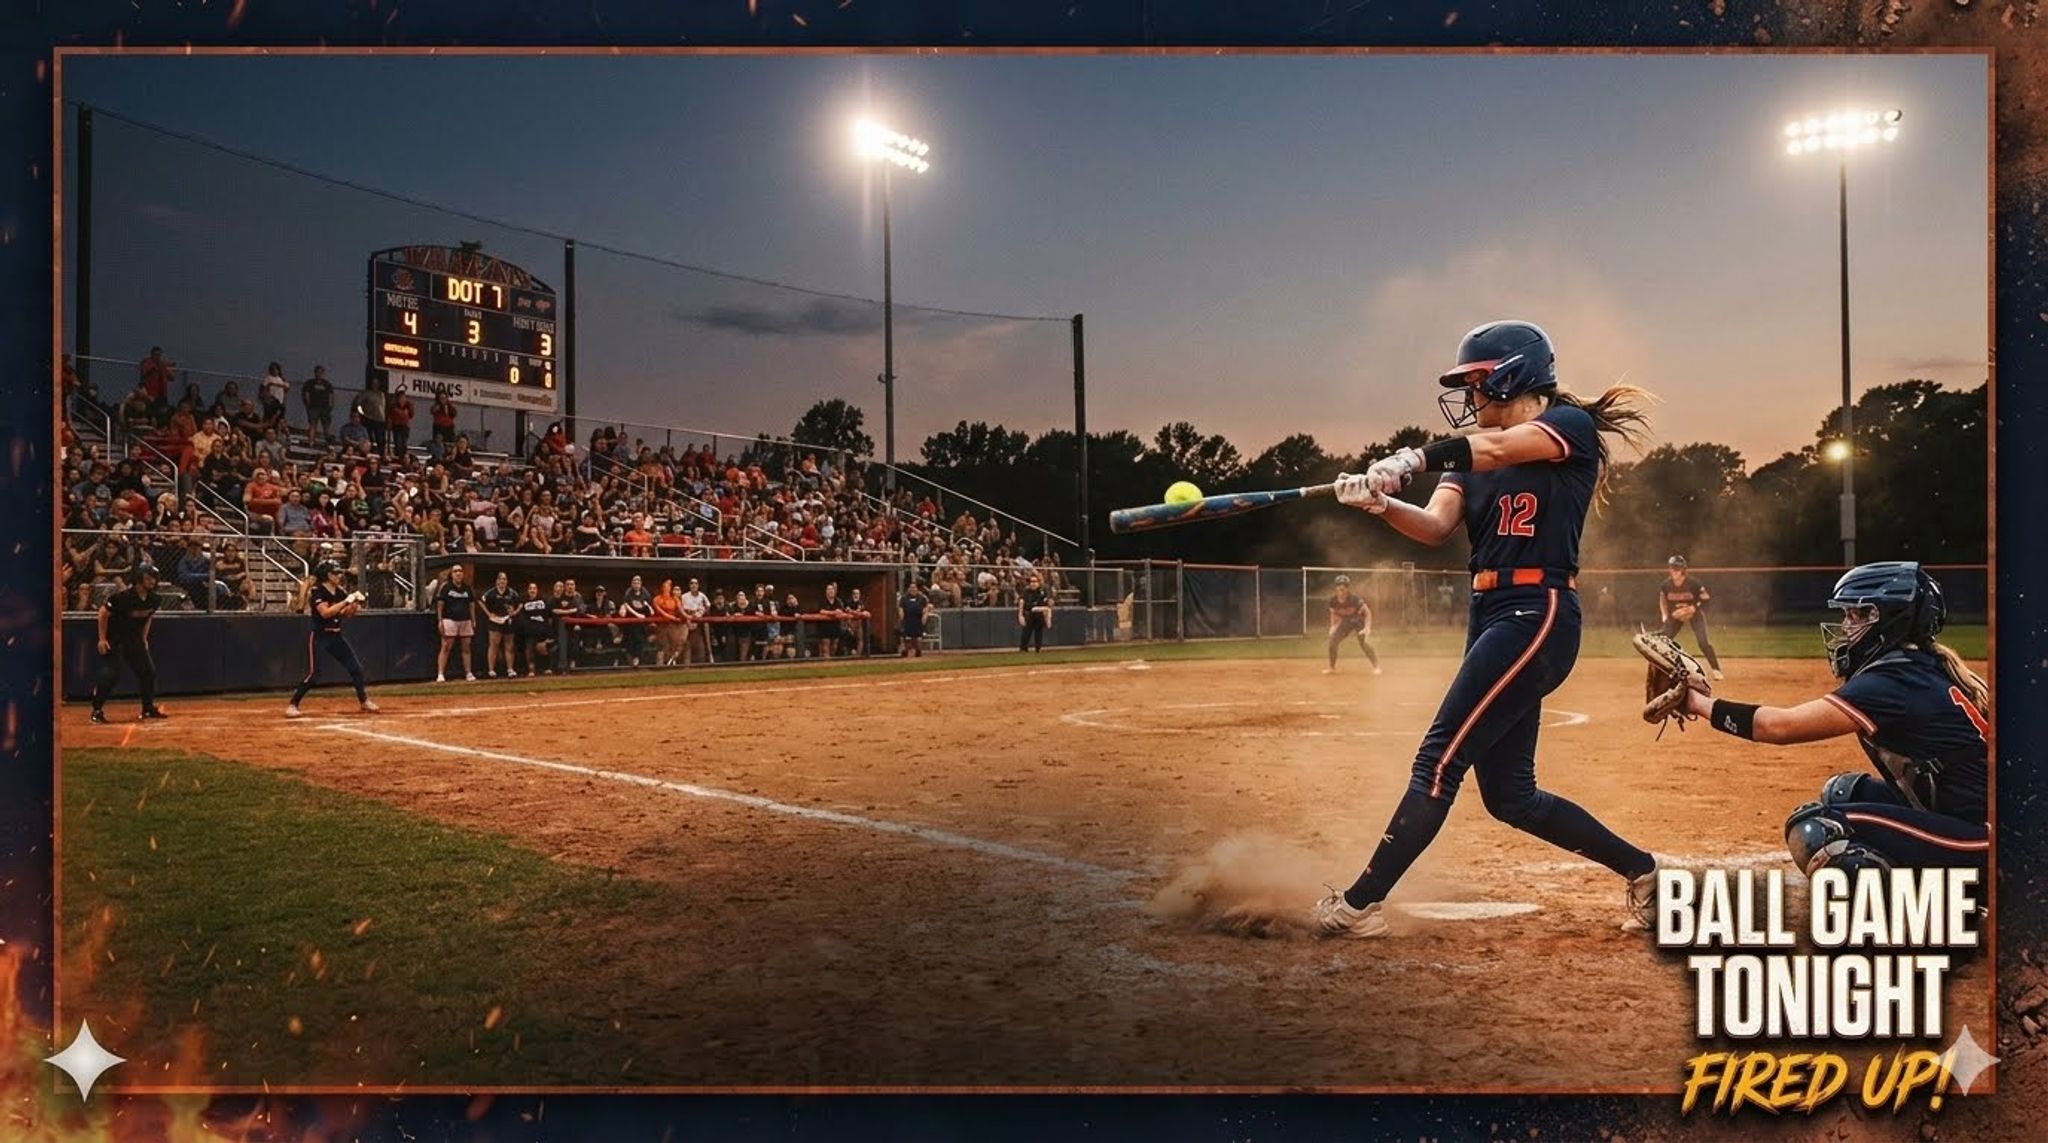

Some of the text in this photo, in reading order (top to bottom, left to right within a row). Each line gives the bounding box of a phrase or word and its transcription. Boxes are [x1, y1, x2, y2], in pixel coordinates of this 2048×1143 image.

[447, 276, 484, 304] DOT
[491, 286, 502, 309] 7
[403, 311, 418, 335] 4
[468, 320, 481, 344] 3
[540, 333, 552, 356] 3
[509, 367, 520, 384] 0
[1497, 492, 1538, 537] 12
